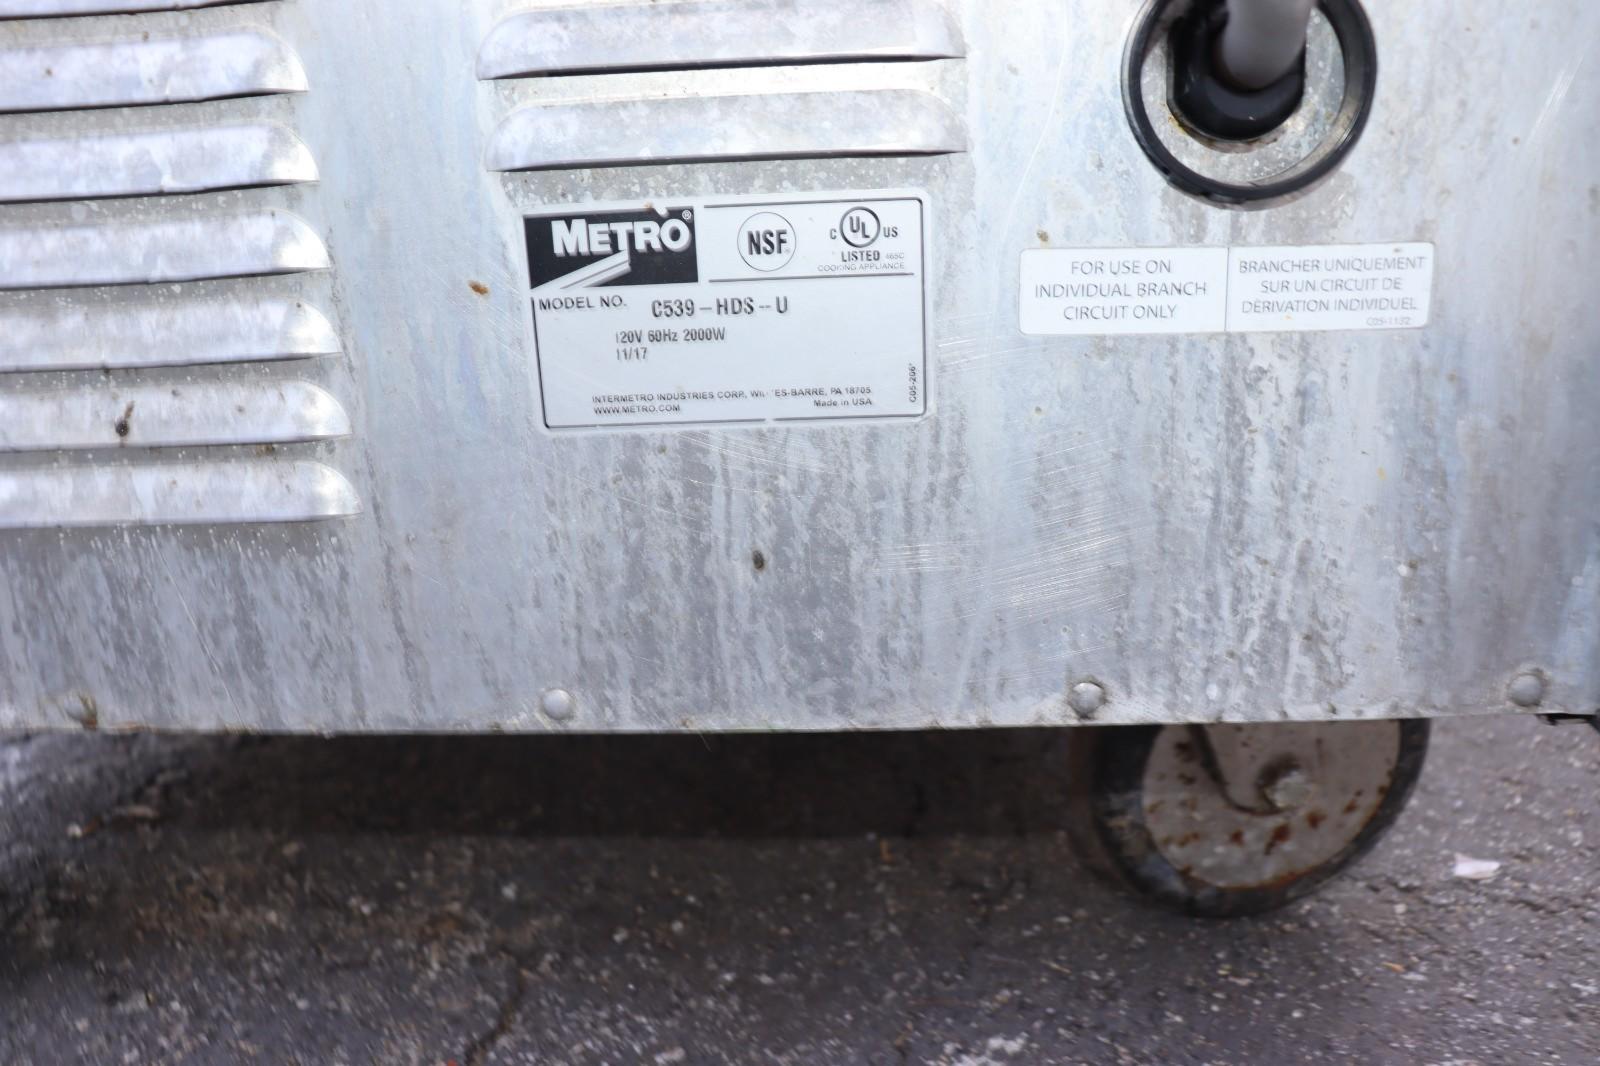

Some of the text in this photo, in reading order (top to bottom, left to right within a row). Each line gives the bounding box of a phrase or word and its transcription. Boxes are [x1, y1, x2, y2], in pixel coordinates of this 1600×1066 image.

[849, 215, 871, 239] UL
[551, 218, 692, 257] METRO
[747, 229, 788, 256] NSF
[841, 250, 880, 263] LISTED
[1239, 256, 1427, 274] BRANCHER UNIQUEMENT
[817, 262, 905, 272] COOKING APPLIANCE
[1071, 258, 1172, 276] FOR USE ON
[1035, 281, 1207, 299] INDIVIDUAL BRANCH
[1260, 276, 1403, 294] SUR UN CIRCUIT DE
[539, 294, 628, 311] MODEL NO.
[1334, 296, 1418, 312] INDIVIDUEL
[1063, 303, 1179, 321] CIRCUIT ONLY
[615, 326, 726, 344] 120V 60Hz 2000W
[616, 346, 648, 361] 11/17
[592, 393, 654, 404] INTERMETRO
[657, 391, 714, 402] INDUSTRIES
[830, 386, 842, 396] PA
[844, 386, 871, 396] 18705
[813, 397, 873, 408] Made in USA
[593, 404, 681, 415] WWW.METRO.COM
